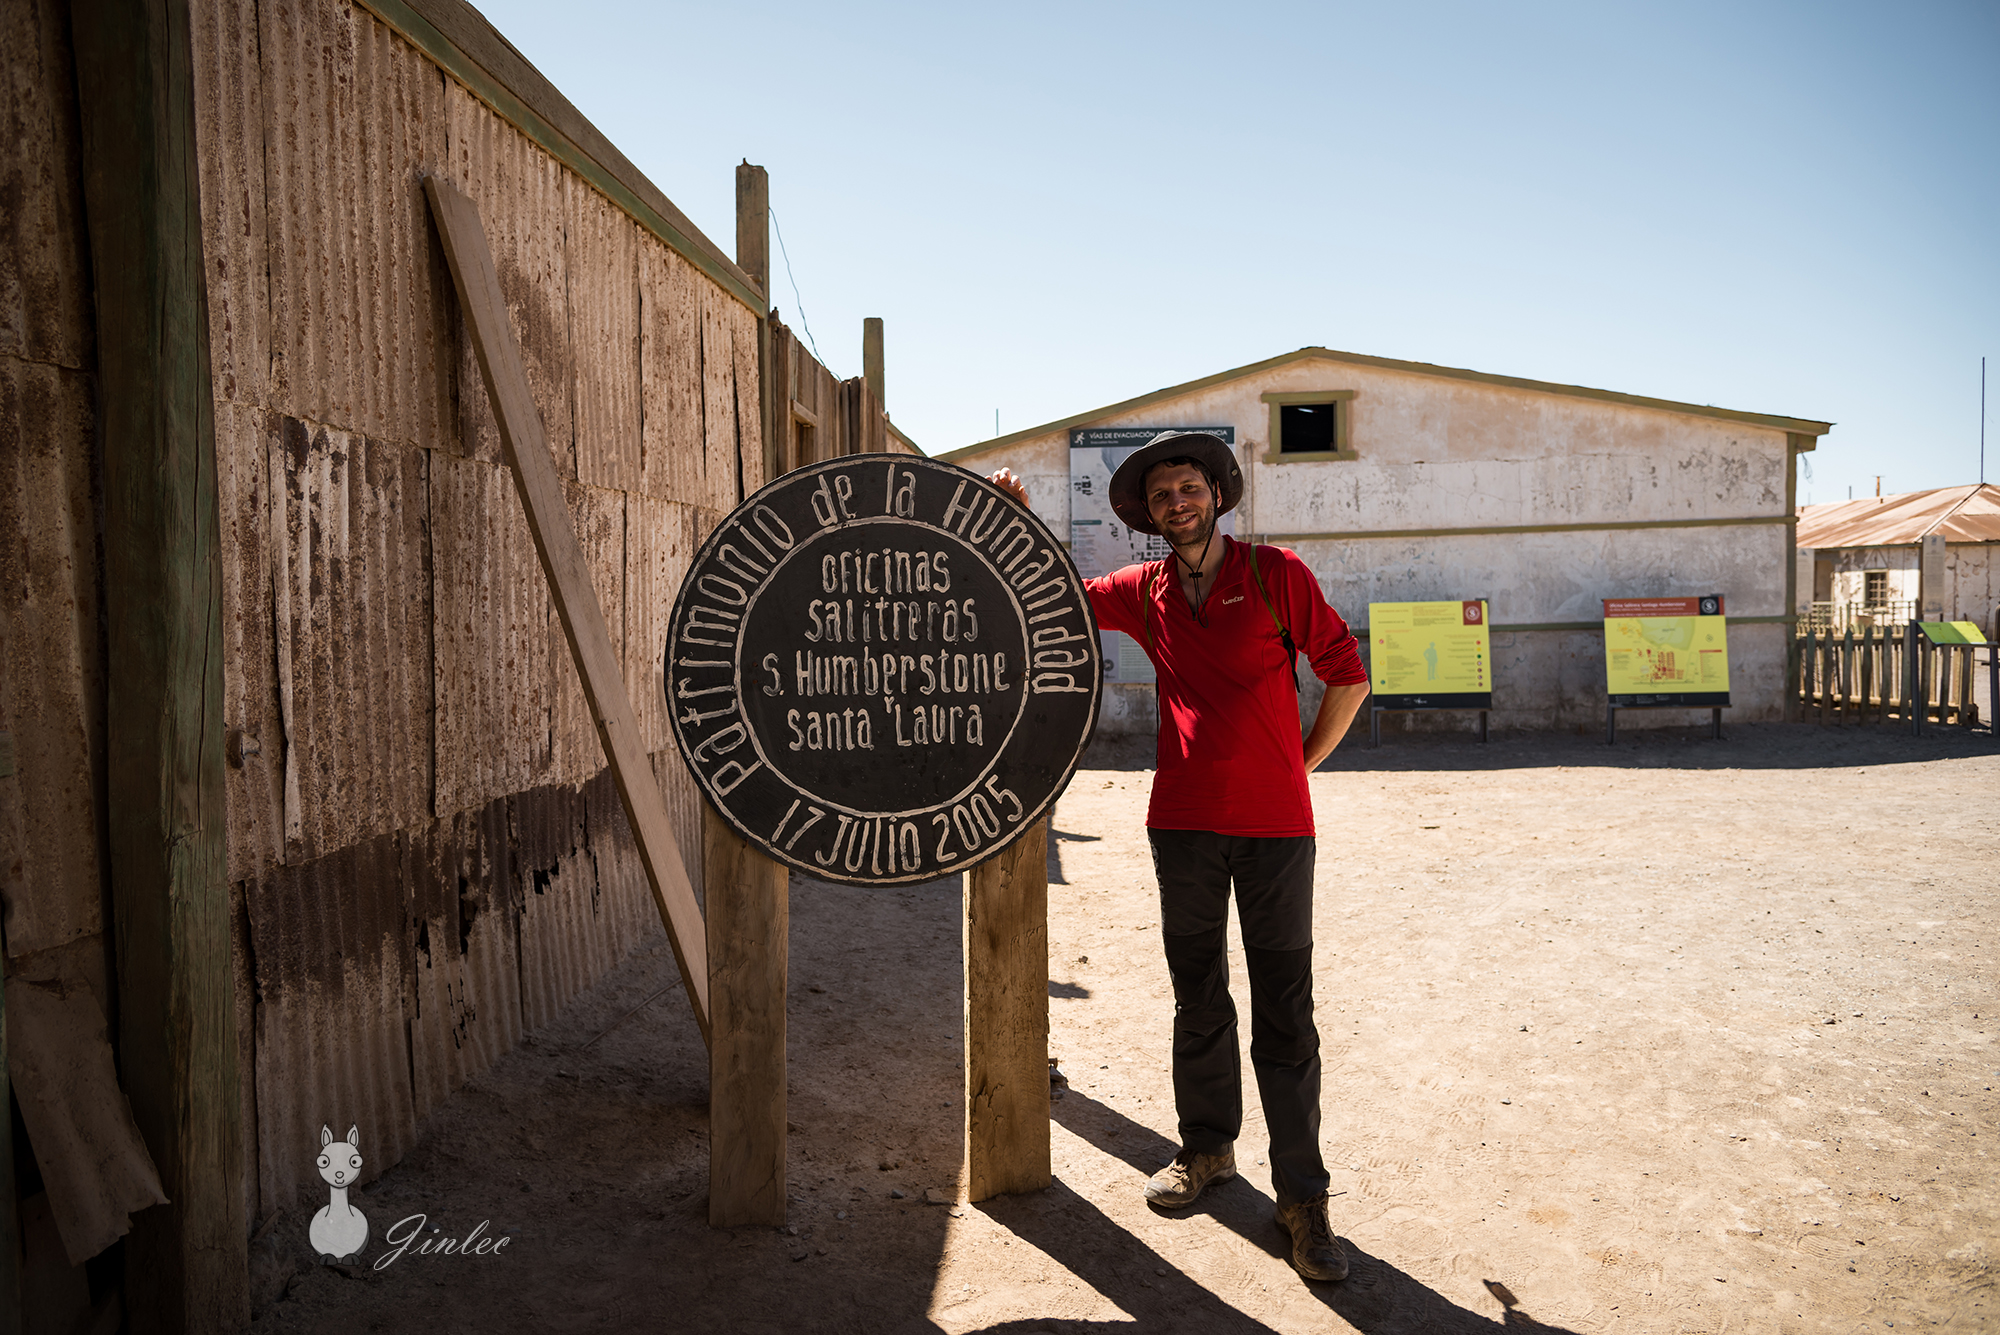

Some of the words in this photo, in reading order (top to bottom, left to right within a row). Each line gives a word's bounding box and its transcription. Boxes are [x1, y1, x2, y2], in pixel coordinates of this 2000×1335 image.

[1089, 431, 1103, 439] VÍAS
[1113, 430, 1156, 439] EVACUACIÓN
[678, 504, 795, 798] Patrimonio
[811, 473, 857, 528] de
[885, 463, 917, 518] la
[942, 479, 1090, 695] Humanidad
[762, 653, 785, 697] S.
[796, 646, 1010, 697] Humberstone
[895, 703, 984, 747] Laura
[771, 799, 826, 851] 17
[932, 774, 1024, 863] 2005
